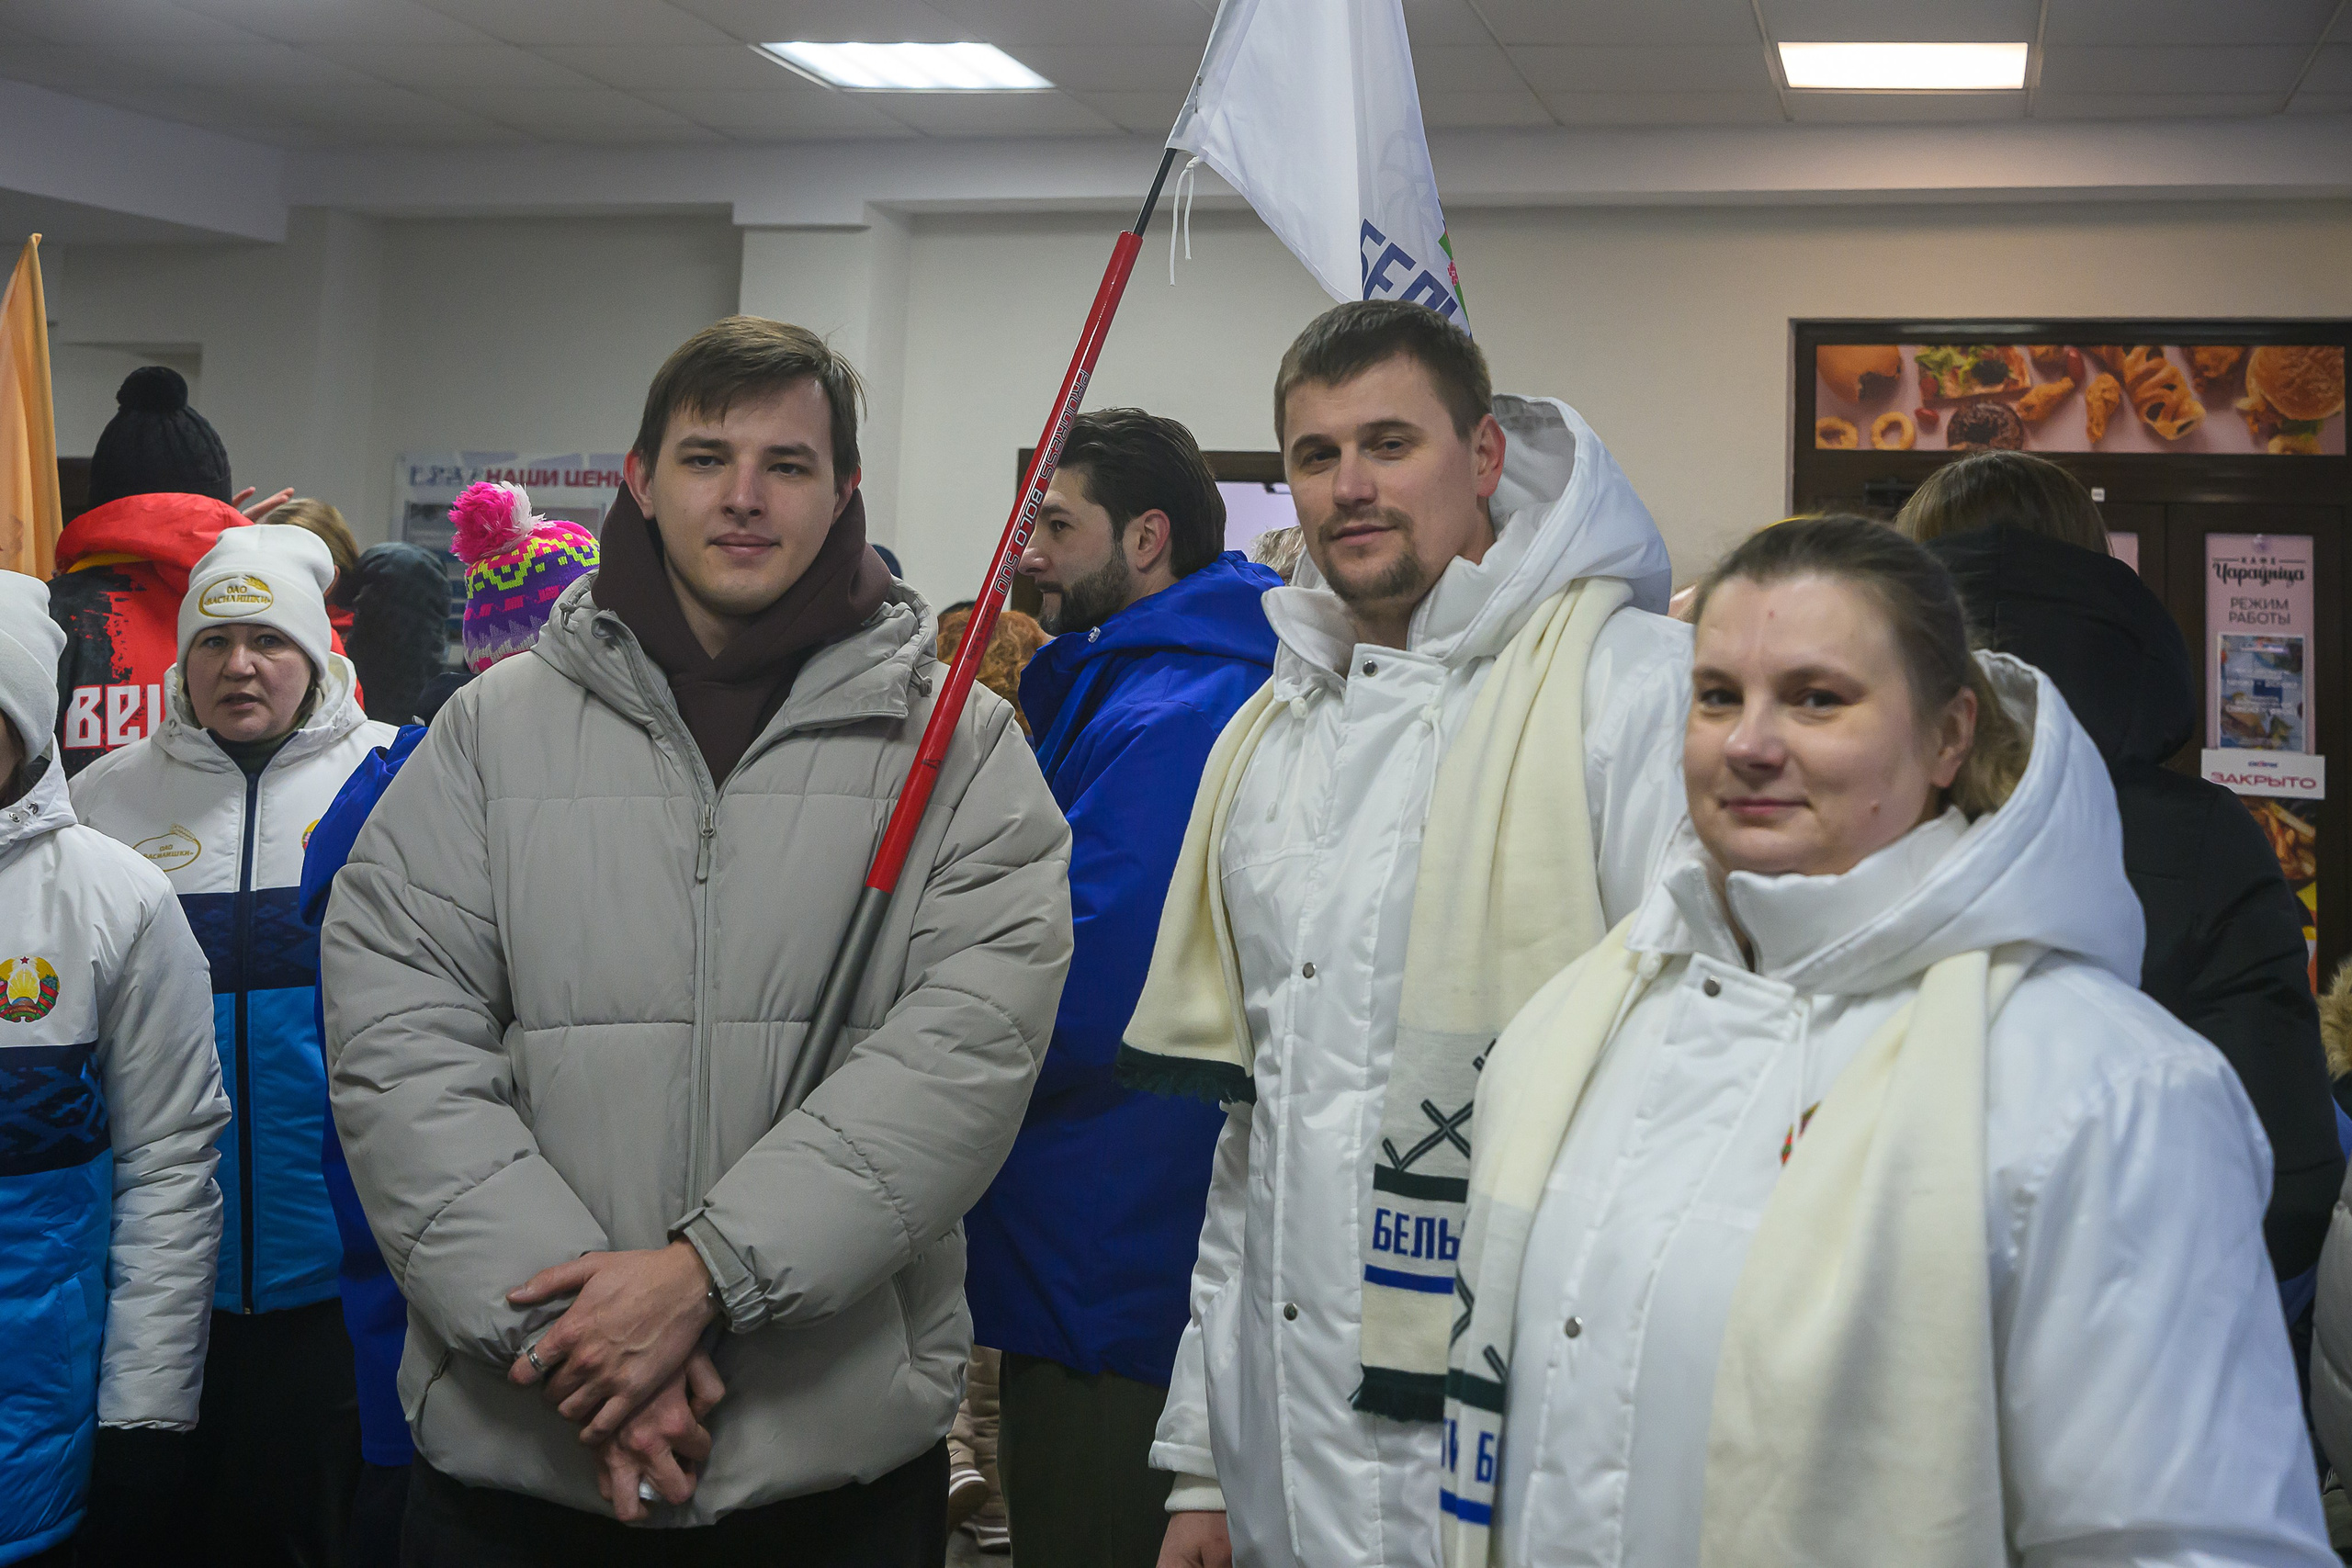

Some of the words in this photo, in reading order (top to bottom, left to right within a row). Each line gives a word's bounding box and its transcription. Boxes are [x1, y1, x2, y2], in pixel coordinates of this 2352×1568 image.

[1039, 368, 1091, 482] PROGRESS
[485, 468, 560, 487] НАШИ
[1014, 487, 1044, 547] BOLO
[995, 550, 1020, 595] 500
[226, 585, 248, 594] ОАО
[2230, 596, 2290, 610] РЕЖИМ
[2228, 611, 2291, 626] РАБОТЫ
[2211, 771, 2317, 790] ЗАКРЫТО
